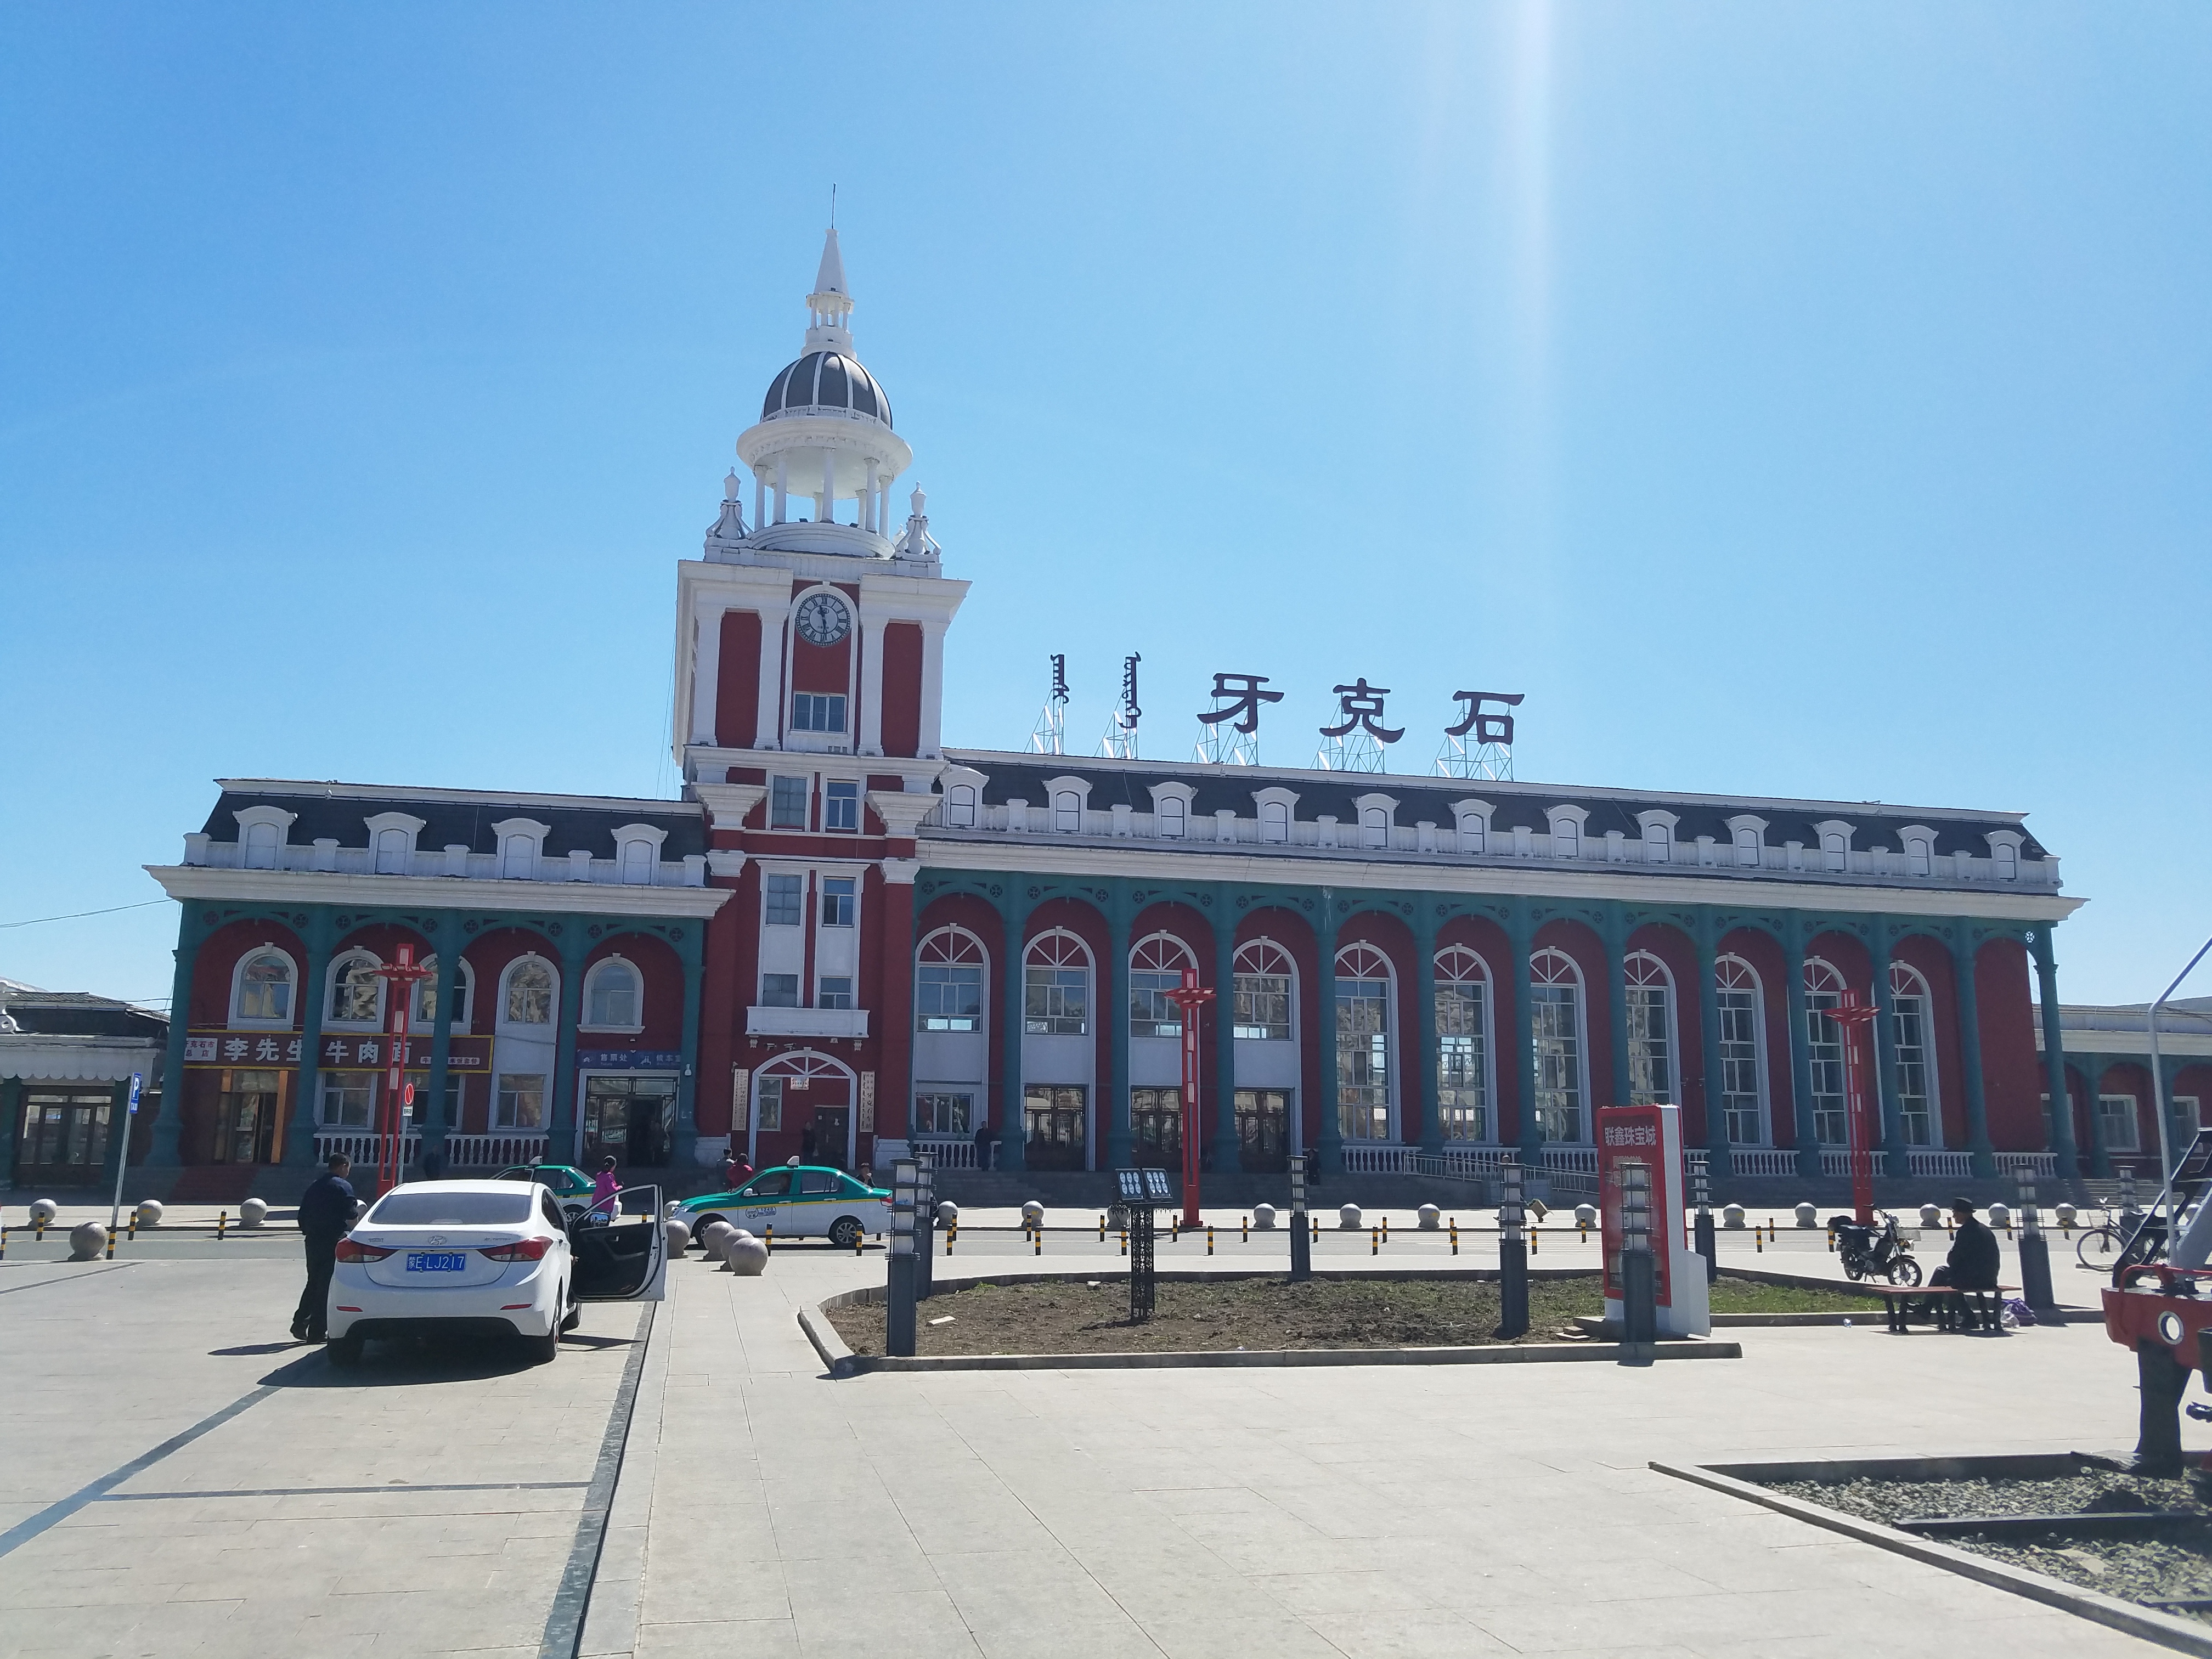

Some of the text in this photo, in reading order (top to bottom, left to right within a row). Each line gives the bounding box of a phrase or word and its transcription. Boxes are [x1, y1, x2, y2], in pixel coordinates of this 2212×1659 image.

[1197, 673, 1525, 745] 牙克石
[601, 1053, 627, 1062] 售票处
[132, 1077, 139, 1098] P
[1604, 1125, 1656, 1147] 联鑫珠宝城
